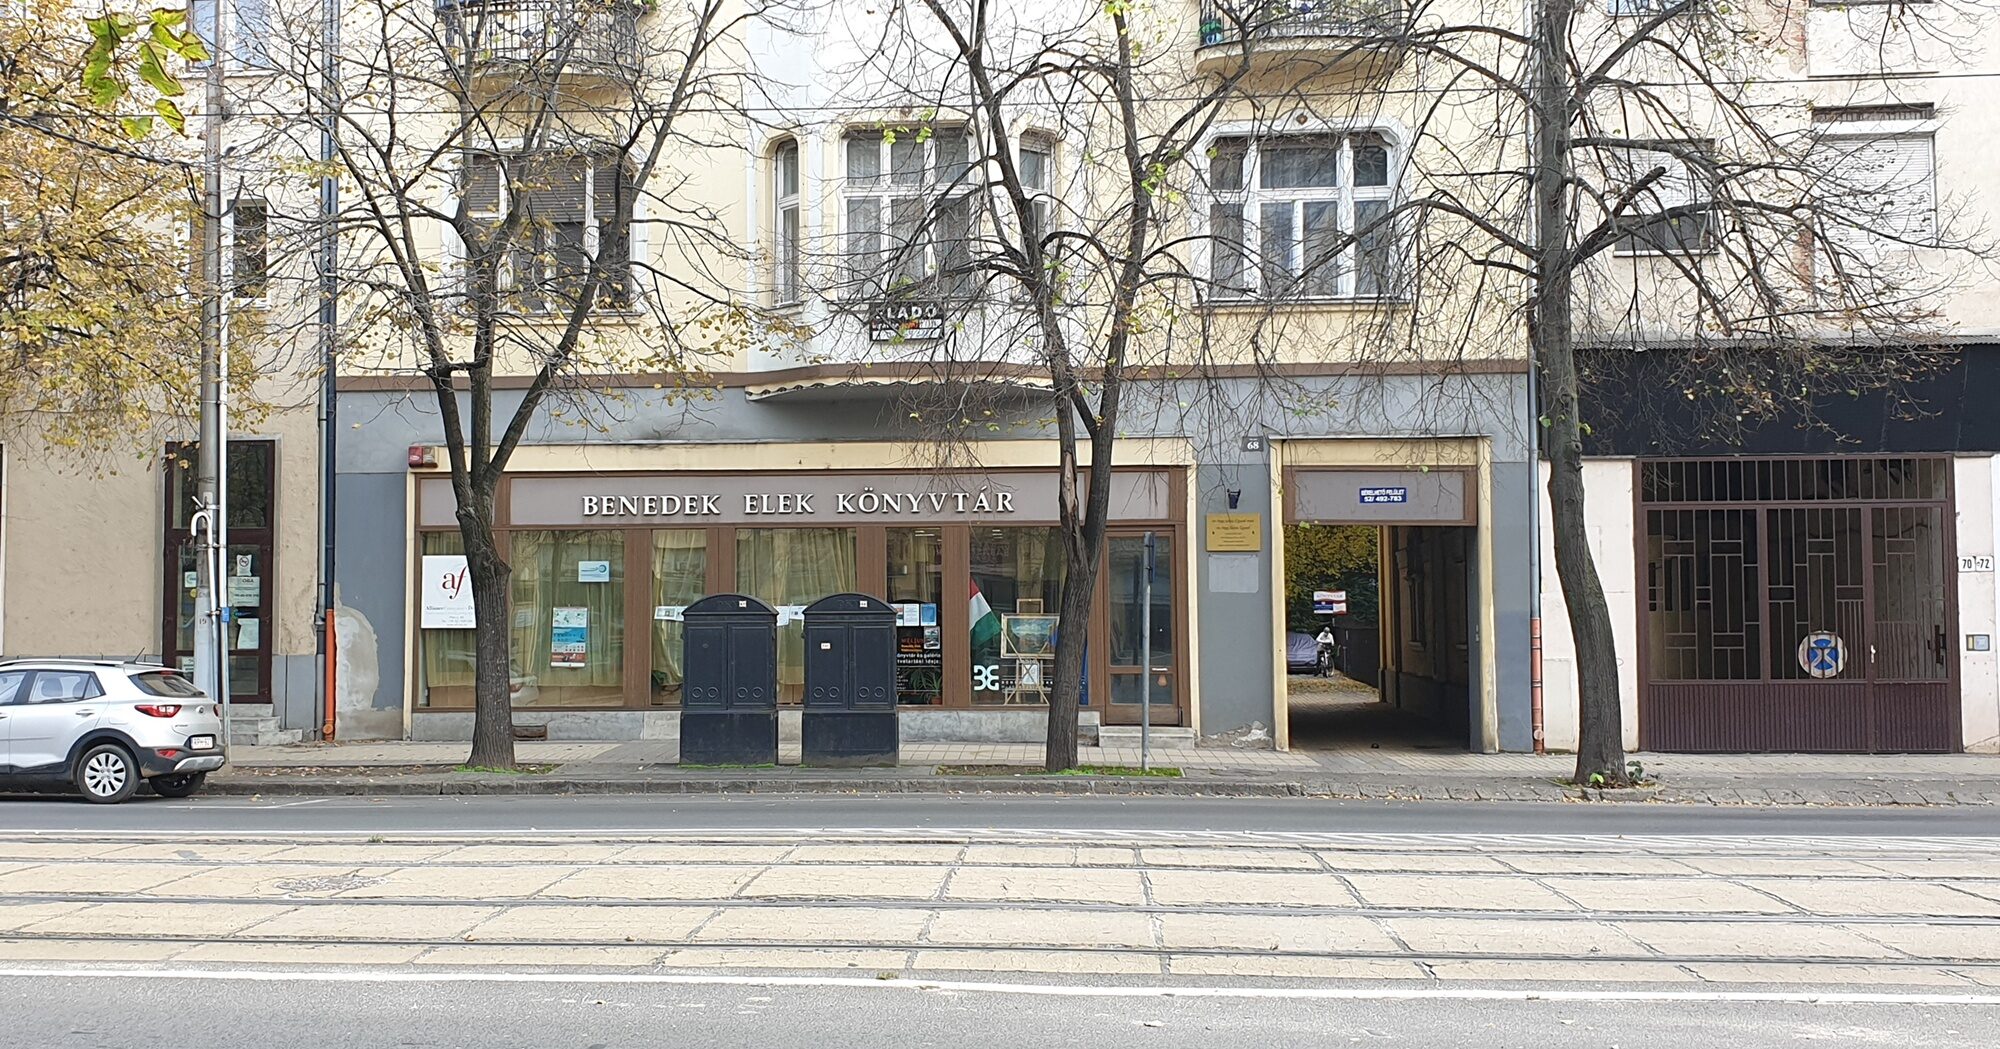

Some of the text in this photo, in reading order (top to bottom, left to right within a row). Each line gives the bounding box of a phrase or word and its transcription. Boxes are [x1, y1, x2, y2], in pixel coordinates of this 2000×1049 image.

[1247, 441, 1259, 450] 68
[582, 485, 1015, 516] BENEDEK ELEK KÖNYVTÁR
[1962, 558, 1972, 569] 70
